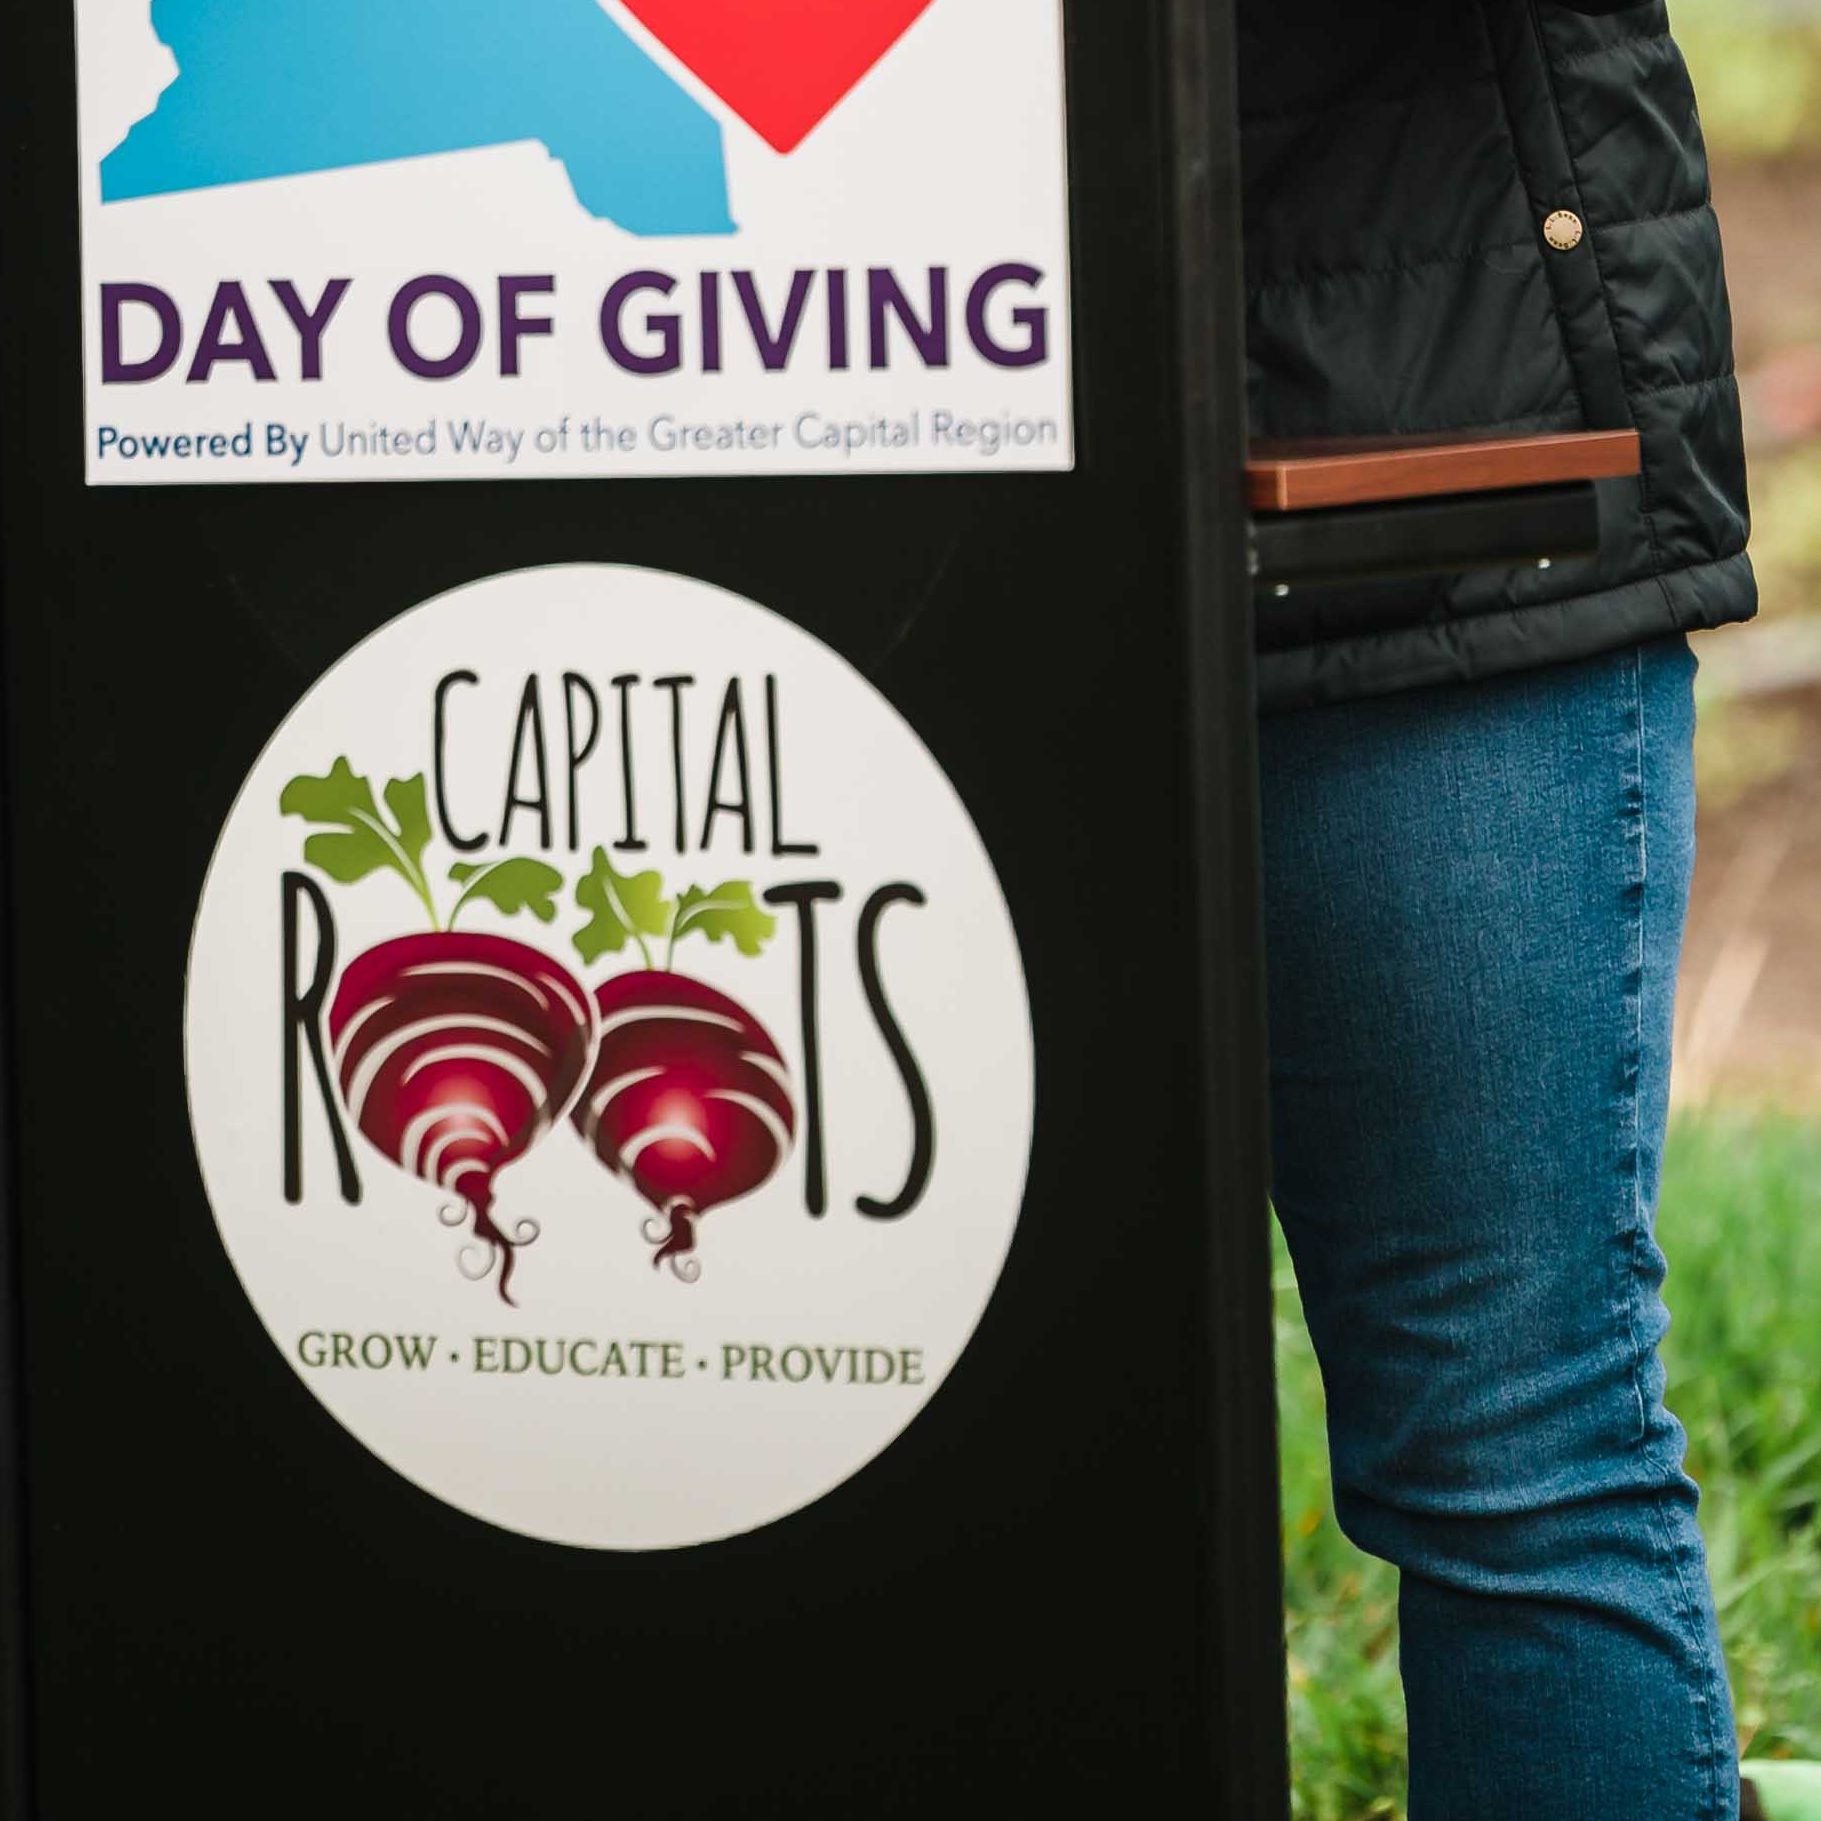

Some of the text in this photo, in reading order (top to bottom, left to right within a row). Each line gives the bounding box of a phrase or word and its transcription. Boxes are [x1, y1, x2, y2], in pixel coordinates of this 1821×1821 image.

[99, 262, 1050, 385] DAY OF GIVING
[97, 410, 1059, 466] Powered By United Way of the Greater Capital Region
[433, 668, 820, 856] CAPITAL
[297, 1330, 927, 1386] GROW EDUCATE PROVIDE
